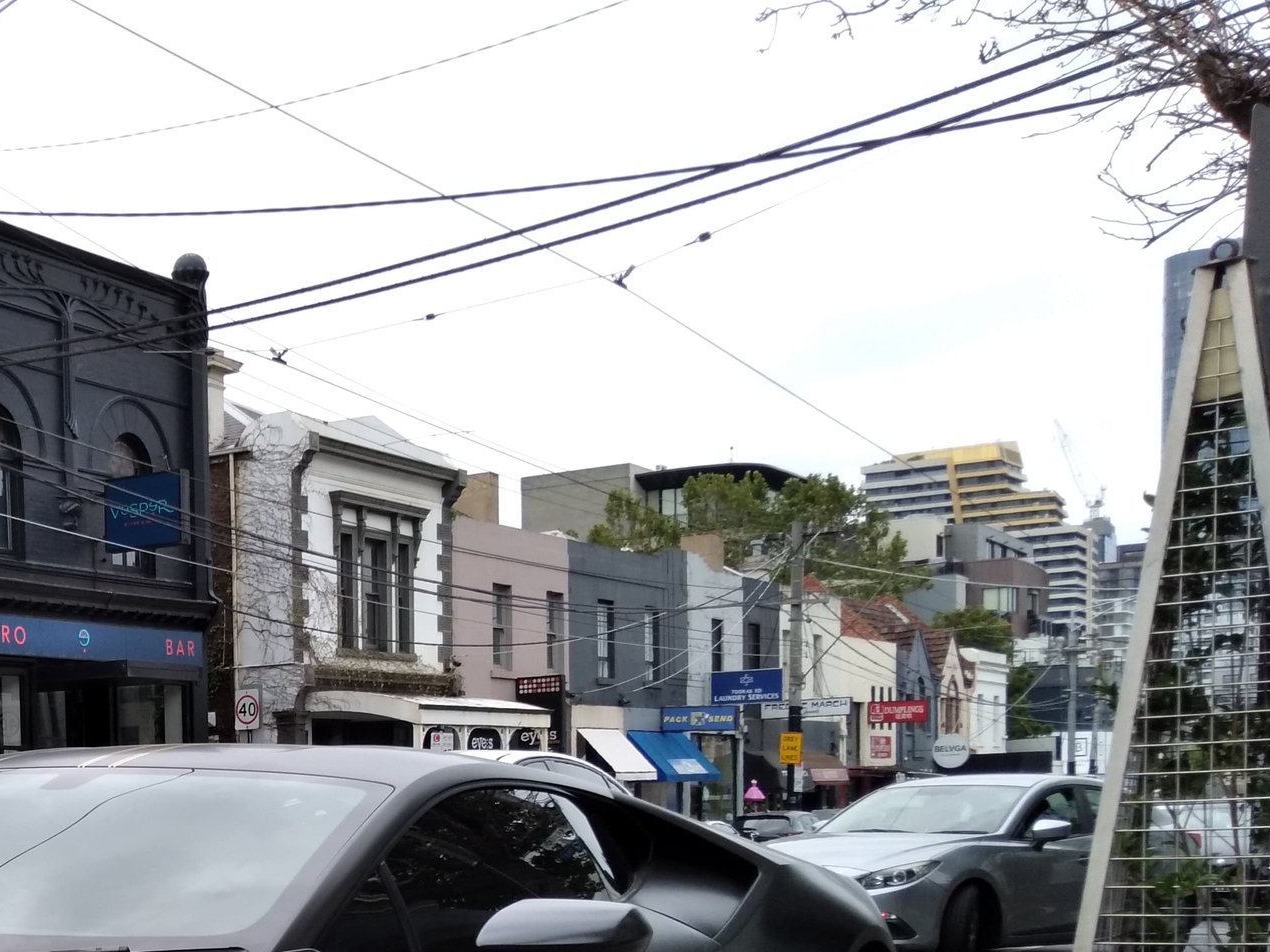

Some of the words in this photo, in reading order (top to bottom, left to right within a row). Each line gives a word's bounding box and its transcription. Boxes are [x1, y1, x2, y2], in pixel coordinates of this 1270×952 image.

[165, 639, 195, 657] BAR
[714, 694, 746, 702] LAUNDRY
[811, 700, 847, 708] MARCH
[238, 702, 256, 717] 40
[884, 705, 924, 714] DUMPLINGS
